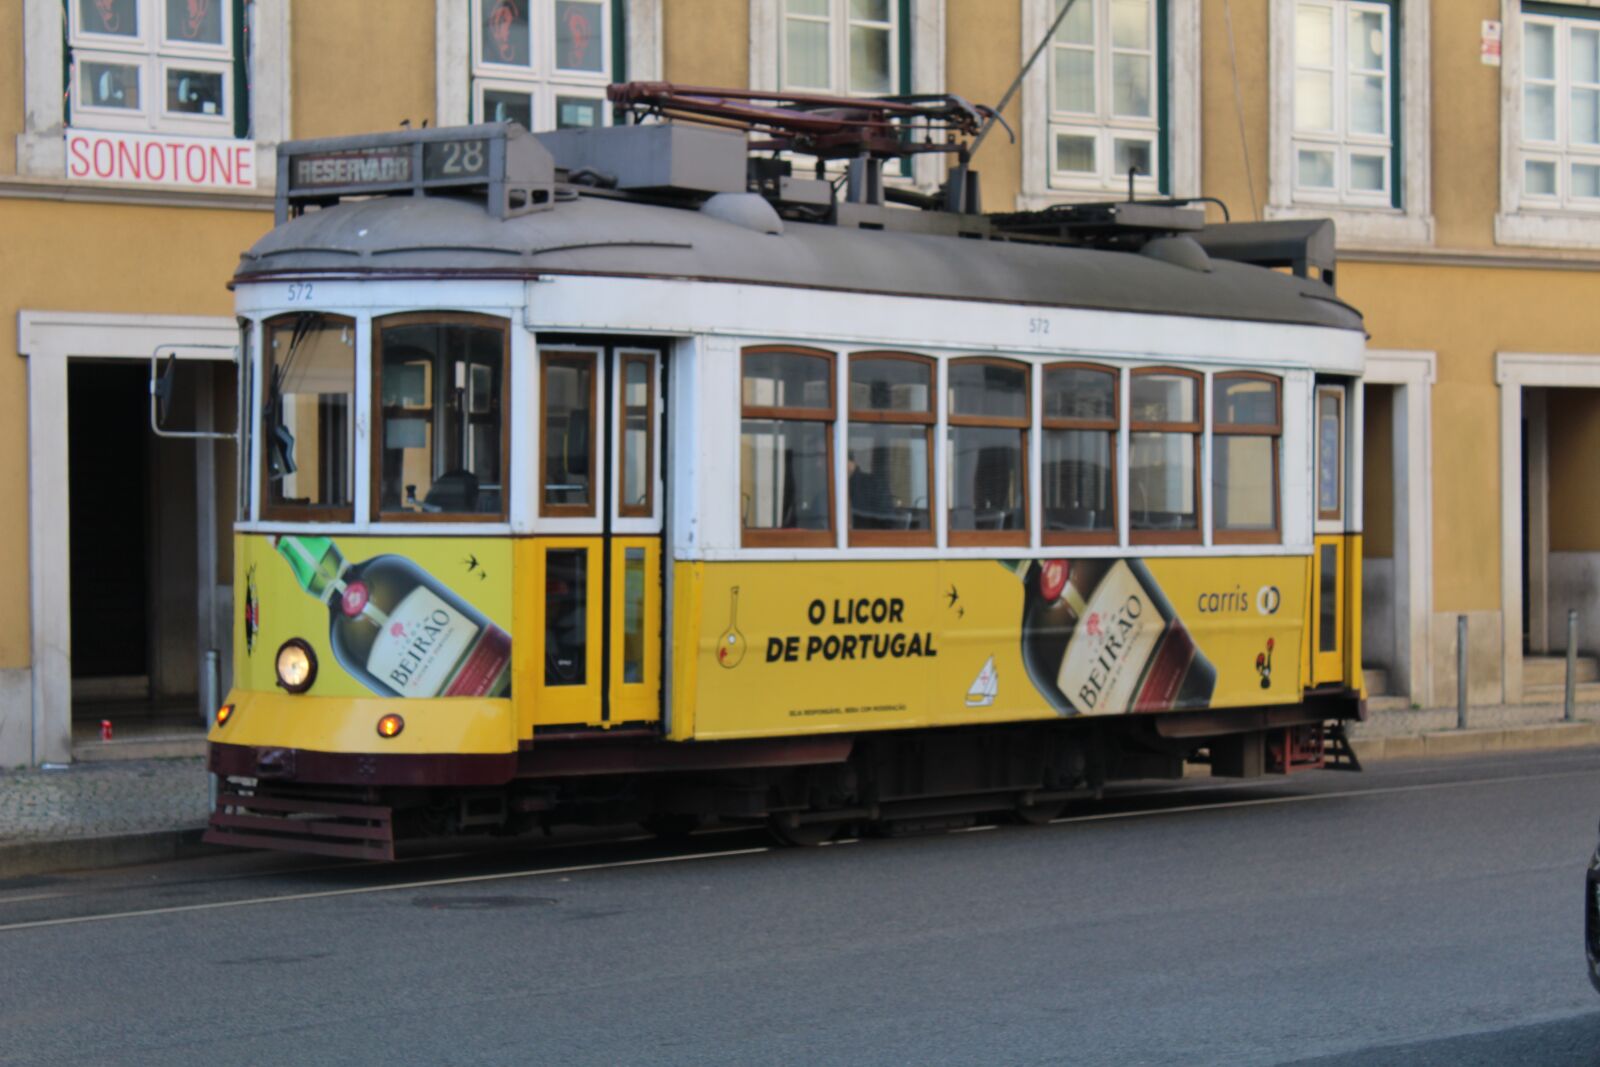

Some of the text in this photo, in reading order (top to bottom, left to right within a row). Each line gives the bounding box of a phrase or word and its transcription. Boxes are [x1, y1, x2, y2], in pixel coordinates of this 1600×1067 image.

[70, 136, 252, 186] SONOTONE
[297, 156, 409, 184] RESERVADO
[442, 140, 484, 174] 28
[287, 283, 314, 301] 572
[1028, 317, 1050, 334] 572
[807, 597, 905, 625] O LICOR
[1197, 584, 1249, 613] carris
[389, 607, 451, 688] BEIRÃO
[765, 632, 938, 663] DE PORTUGAL
[1077, 593, 1142, 711] BEIRÃO
